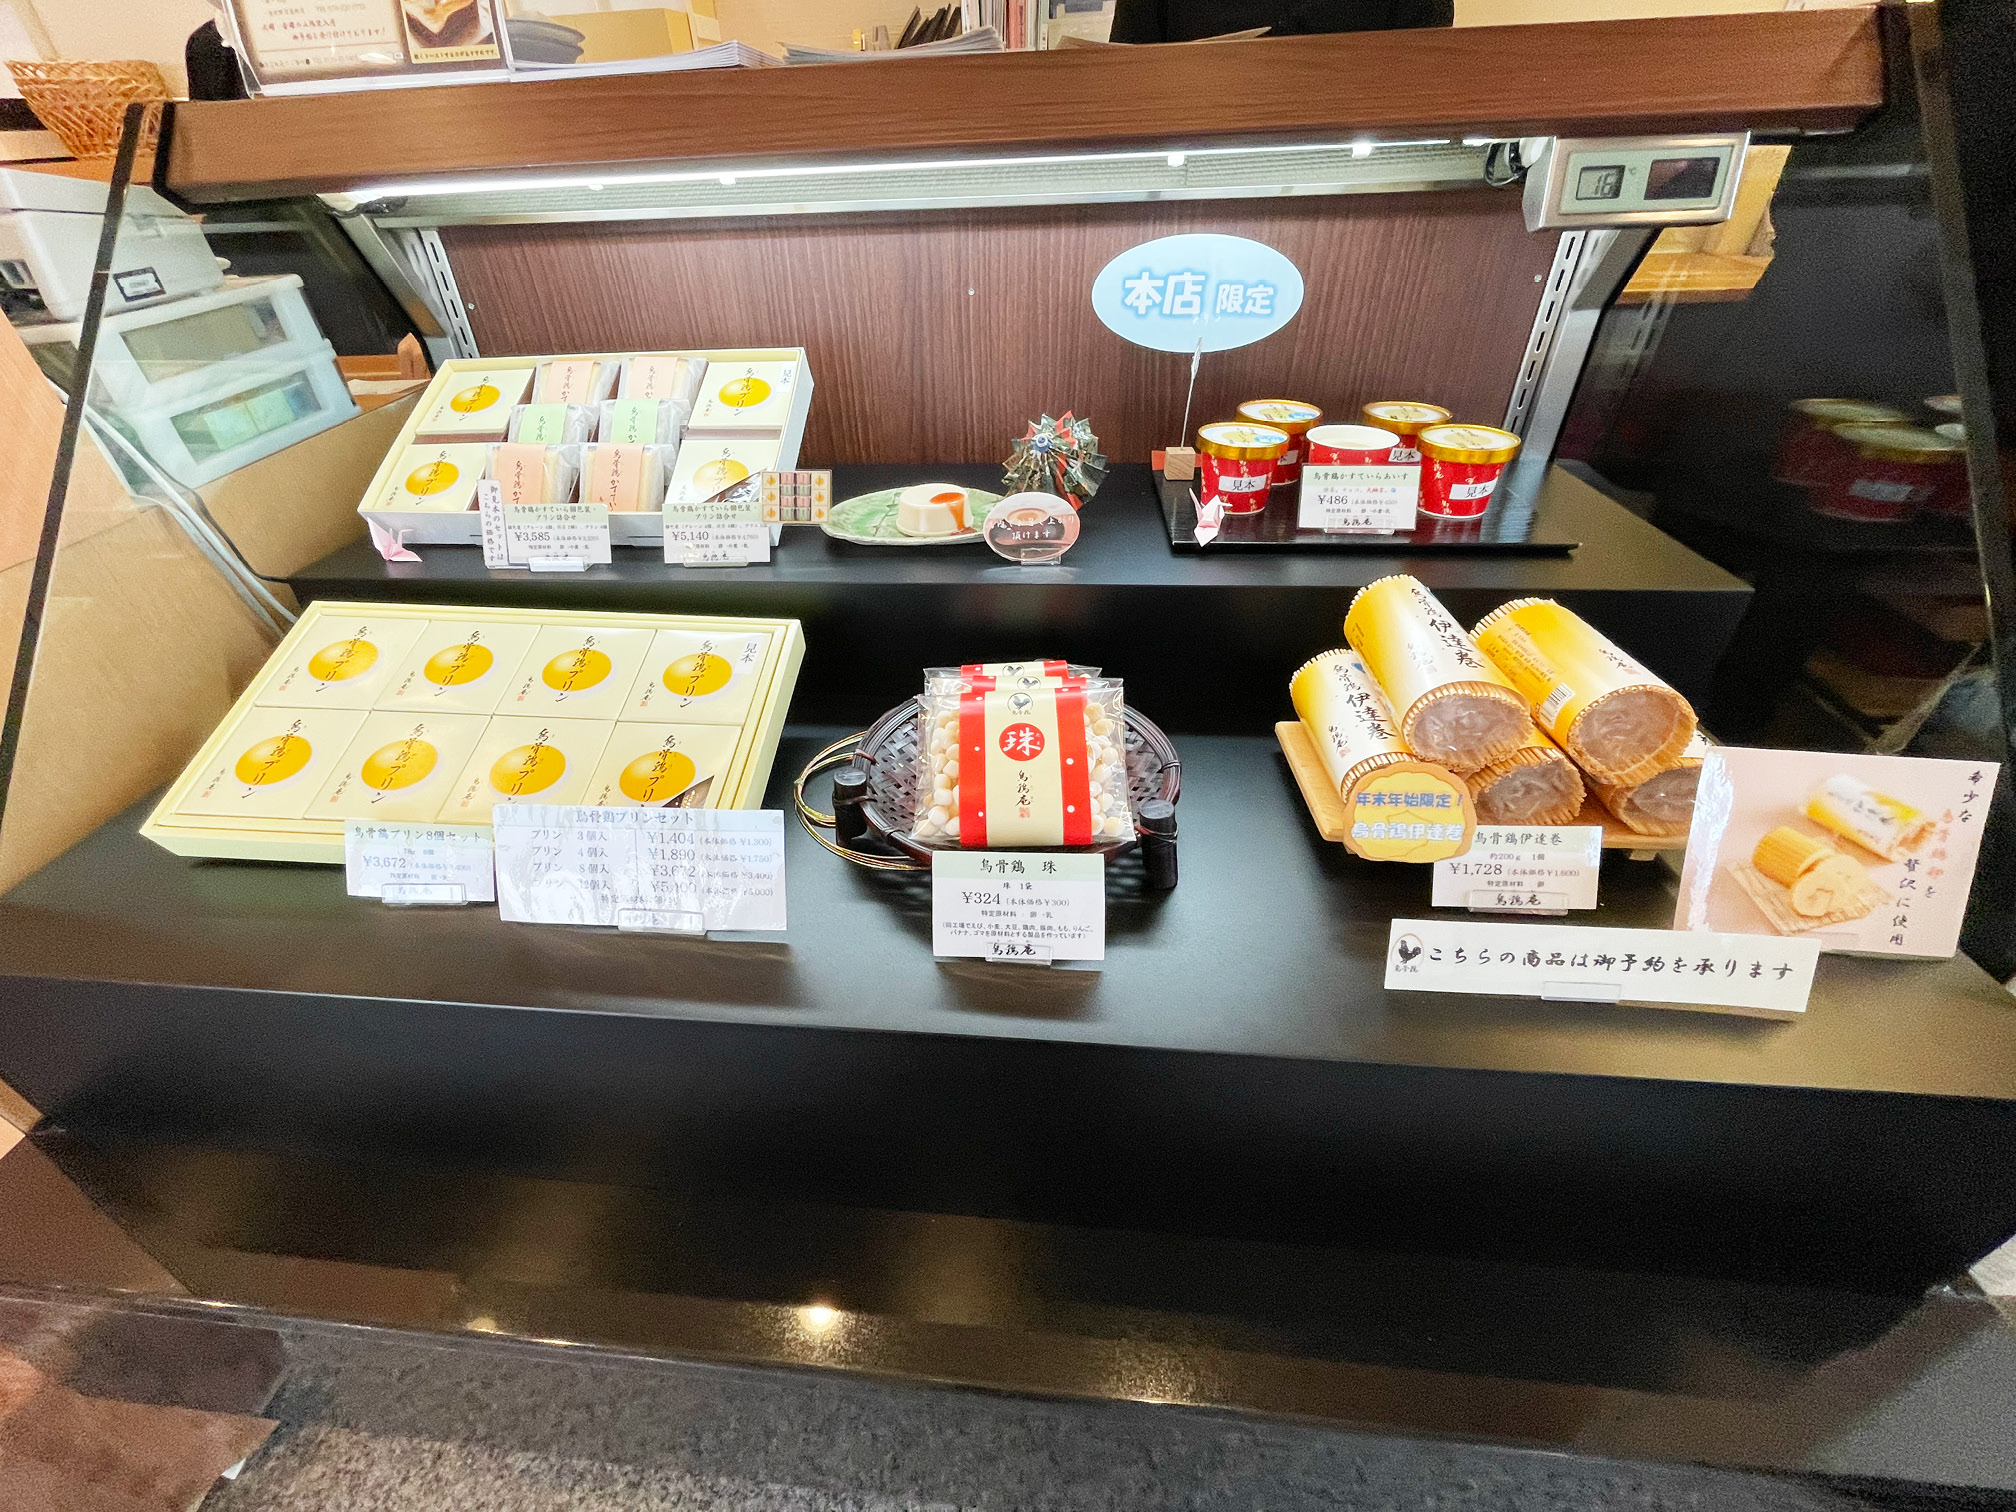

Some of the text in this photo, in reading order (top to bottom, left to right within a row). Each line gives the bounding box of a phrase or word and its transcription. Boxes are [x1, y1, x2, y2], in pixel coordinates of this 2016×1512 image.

[1124, 271, 1274, 315] 本店 限定
[780, 369, 792, 384] 見本
[1391, 449, 1416, 462] 見本
[1232, 480, 1256, 491] 見本
[1465, 484, 1490, 498] 見本
[1318, 495, 1348, 505] ¥486
[484, 493, 495, 561] こちらの価格です
[490, 486, 504, 560] 御見本のセットは
[515, 532, 551, 542] ¥3,585
[672, 531, 709, 542] ¥5,140
[741, 642, 758, 664] 見本
[1002, 727, 1041, 757] 珠
[1356, 792, 1463, 808] 年末年始限定！
[1959, 769, 1984, 823] 希少な
[531, 829, 562, 839] プリン
[648, 832, 695, 844] ¥1,404
[1475, 831, 1563, 846] 烏骨鶏伊達巻
[532, 846, 562, 856] プリン
[648, 848, 695, 861] ¥1,890
[1490, 853, 1545, 861] 約200g 1個
[363, 856, 406, 868] ¥3,672
[533, 863, 563, 873] プリン
[980, 858, 1057, 874] 烏骨鶏 珠
[1449, 863, 1503, 876] ¥1,728
[1003, 882, 1033, 891] 珠 1袋
[962, 891, 1001, 905] ¥324
[1890, 858, 1920, 946] 贅沢に使用
[1429, 946, 1794, 981] こちらの商品は御予約を承ります
